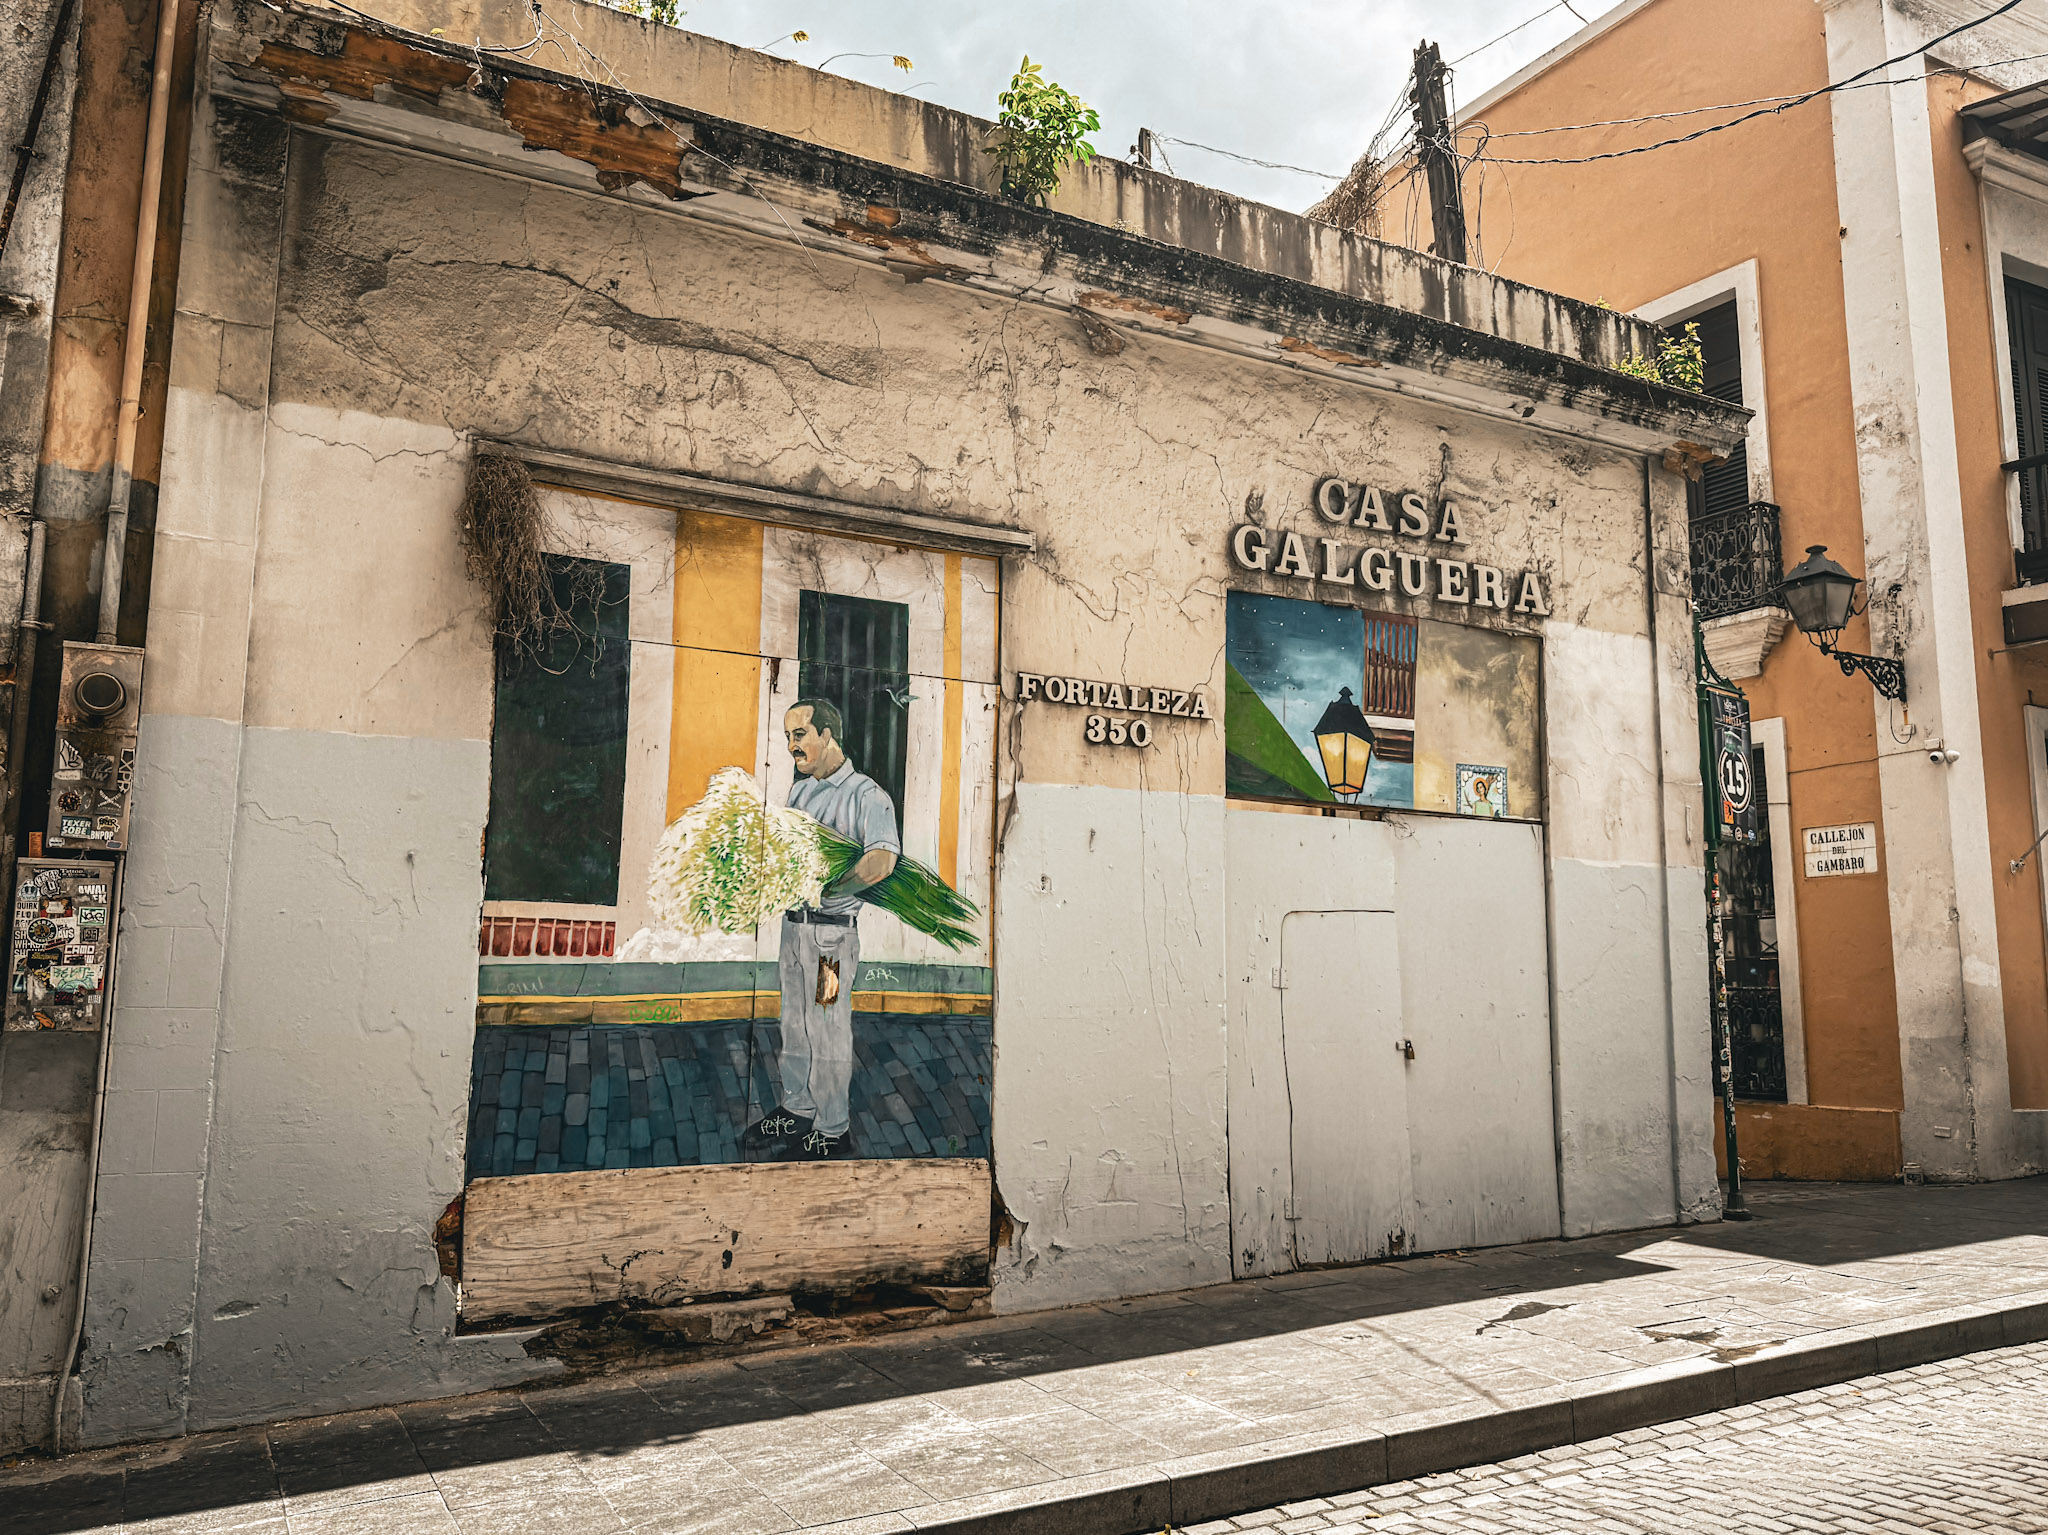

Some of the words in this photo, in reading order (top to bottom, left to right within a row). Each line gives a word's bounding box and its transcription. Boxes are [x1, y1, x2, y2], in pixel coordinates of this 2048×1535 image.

[1317, 478, 1470, 547] CASA
[1233, 524, 1550, 616] GALGUERA
[1018, 672, 1213, 719] FORTALEZA
[1086, 714, 1152, 747] 350
[1725, 759, 1744, 796] 15
[61, 826, 88, 835] SOBE
[62, 819, 92, 828] TEXER
[1810, 827, 1865, 845] CALLEJON
[1832, 845, 1847, 855] DEL
[1817, 856, 1864, 872] GAMBARO
